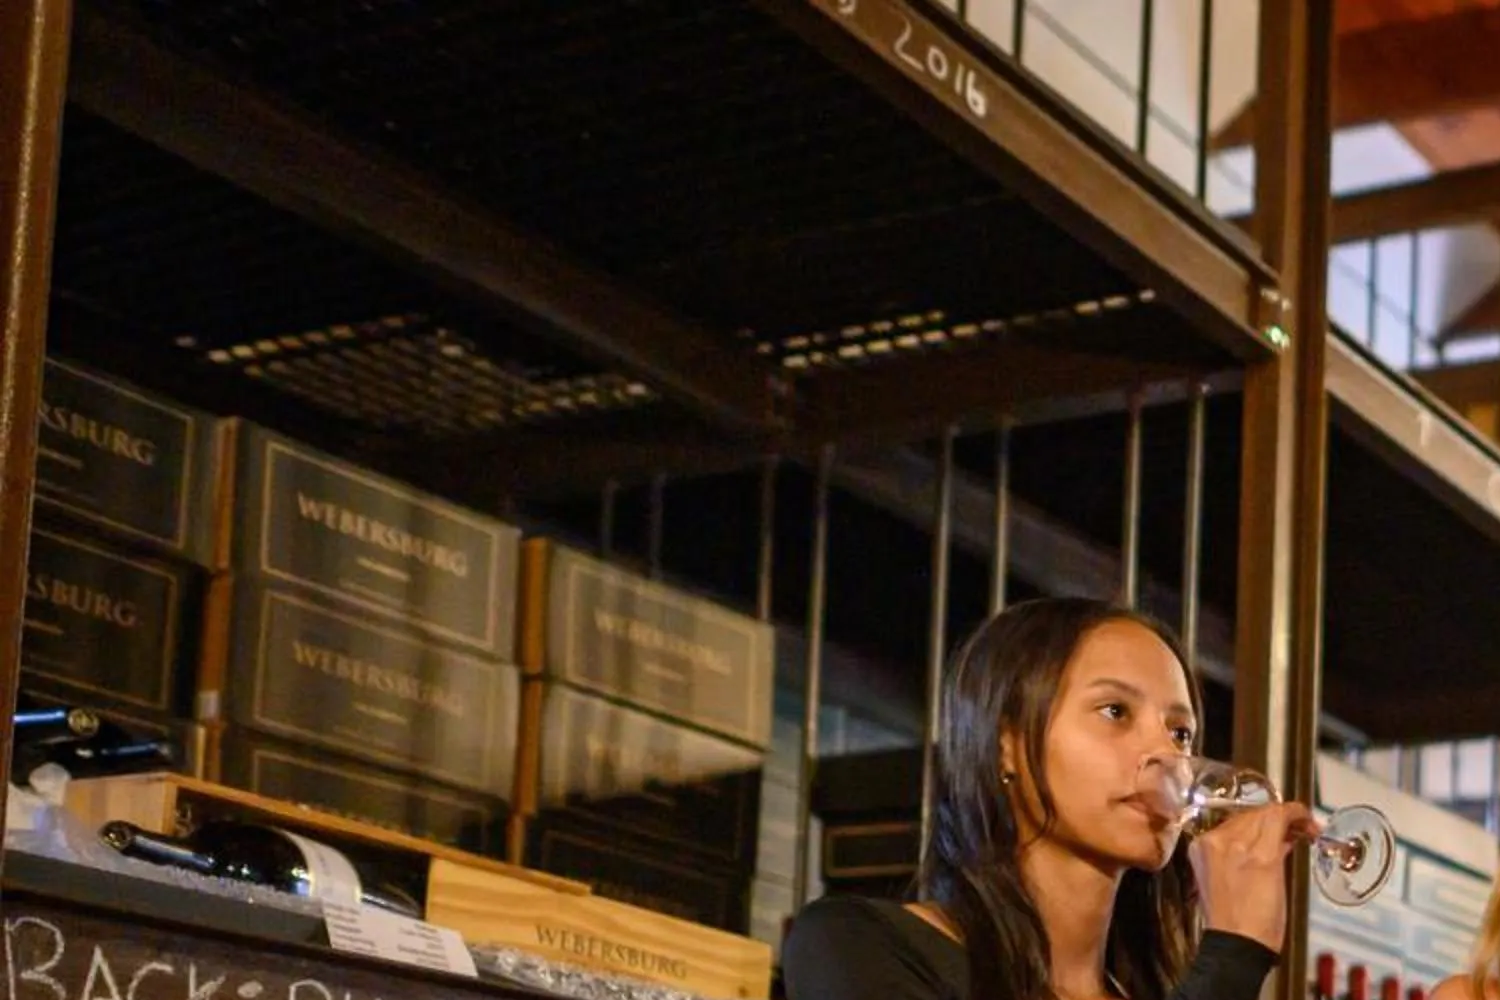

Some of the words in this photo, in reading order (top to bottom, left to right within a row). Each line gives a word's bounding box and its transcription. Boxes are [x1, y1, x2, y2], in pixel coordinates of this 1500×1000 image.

[893, 15, 988, 118] 2016
[296, 491, 468, 578] WEBERSBURG
[28, 570, 139, 628] SBURG
[291, 640, 465, 717] WEBERSBURG
[533, 922, 688, 981] WEBERSBURG
